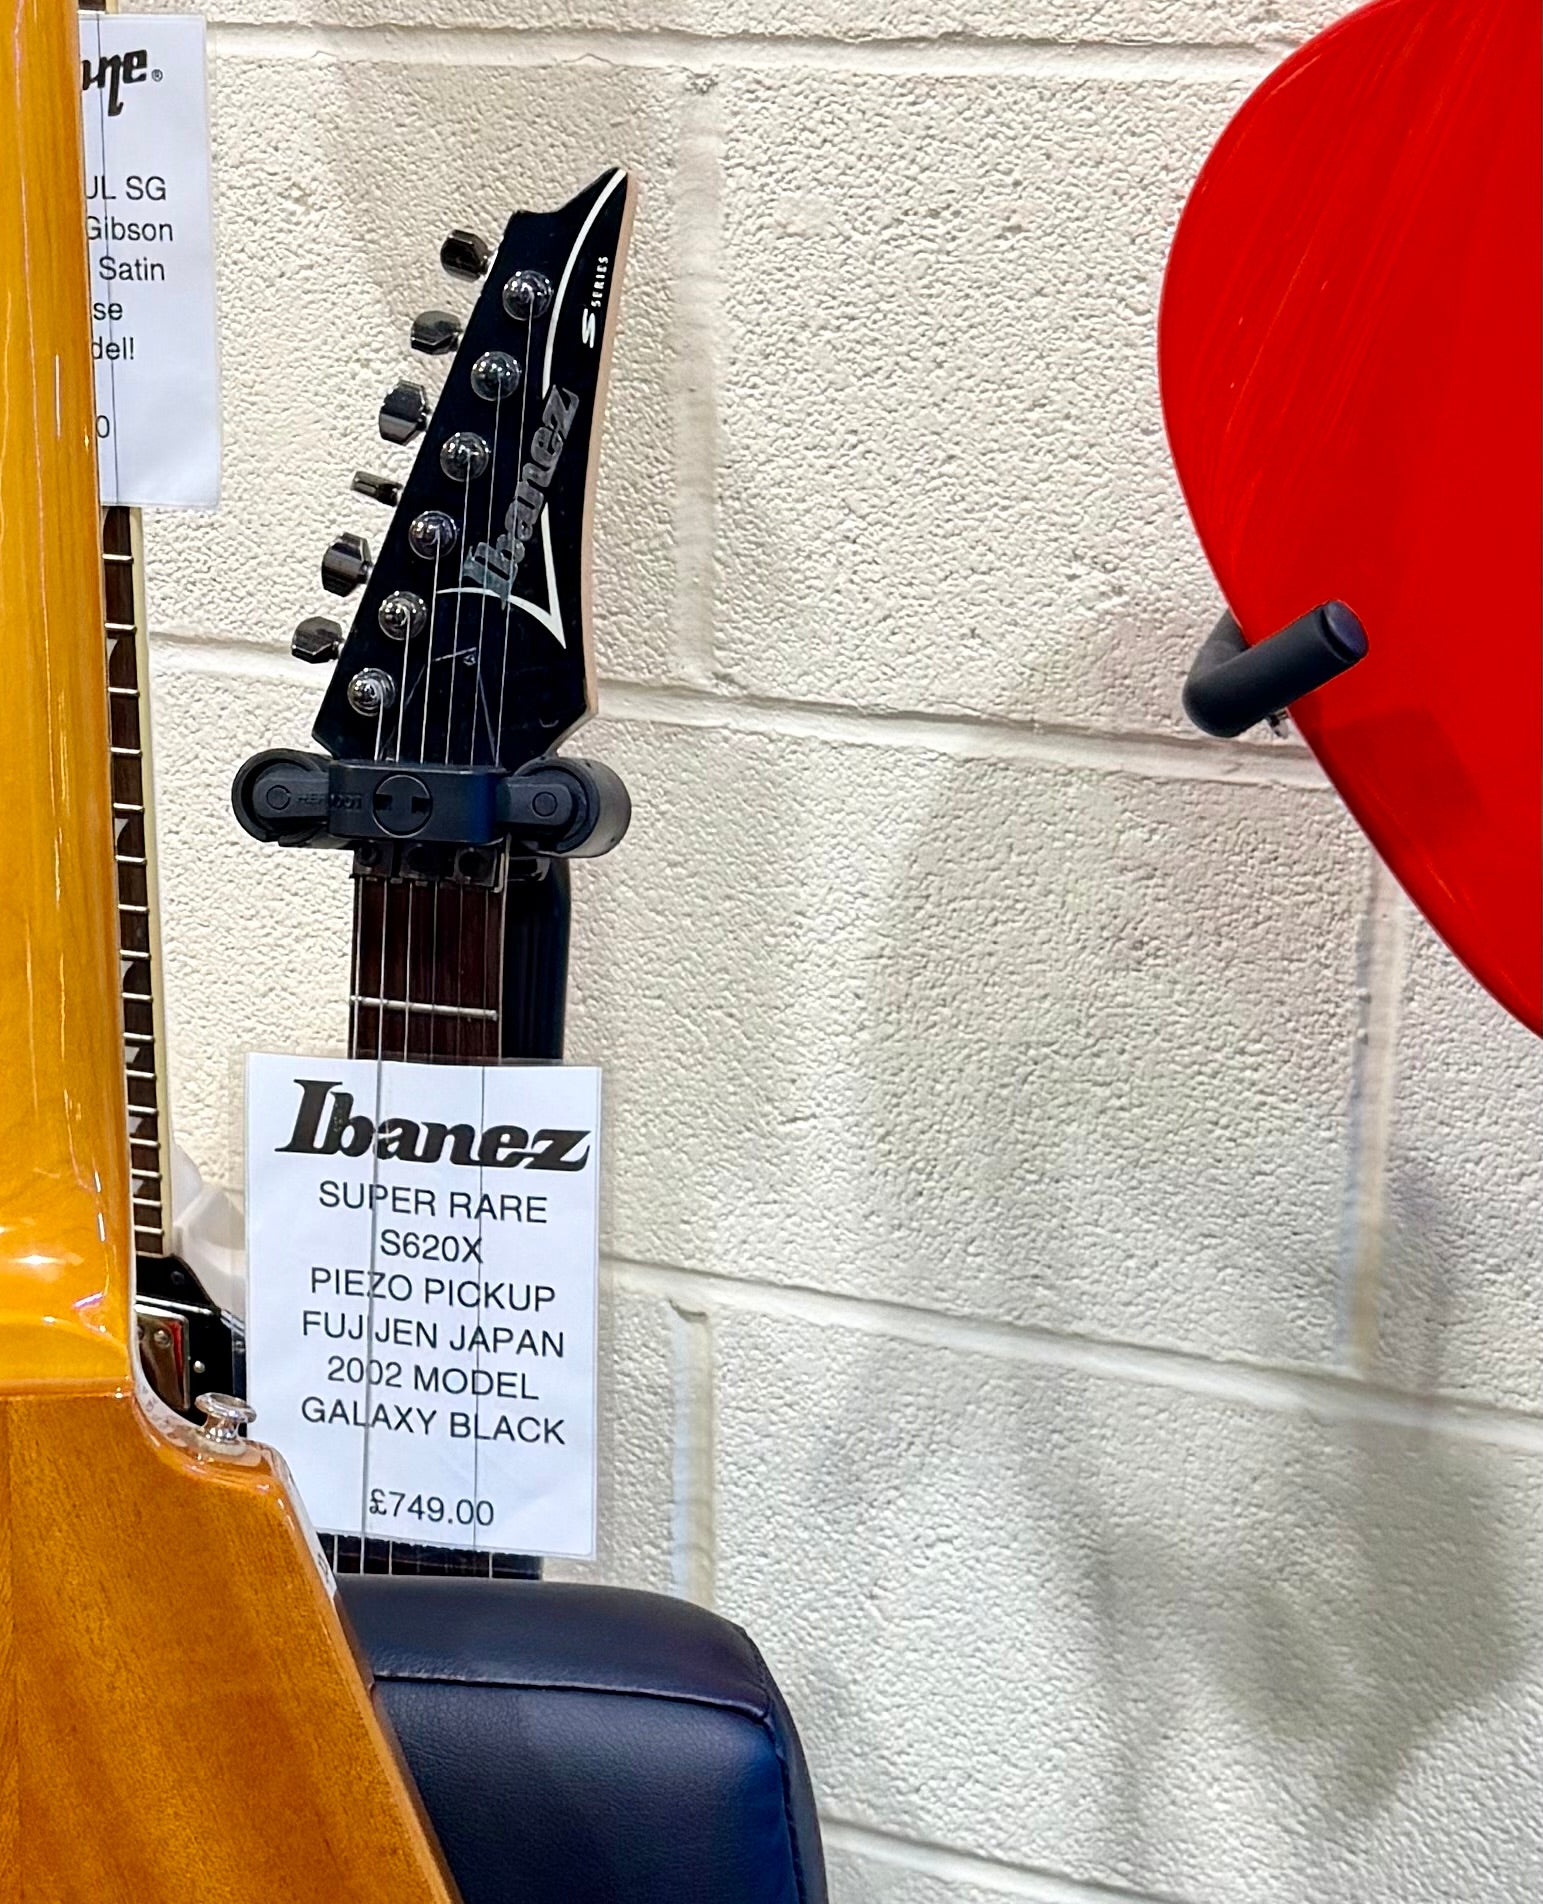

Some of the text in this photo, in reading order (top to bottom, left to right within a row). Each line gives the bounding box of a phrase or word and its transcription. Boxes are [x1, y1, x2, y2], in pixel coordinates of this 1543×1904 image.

[125, 175, 167, 201] SG
[87, 215, 174, 242] Gibson
[99, 255, 166, 282] Satin
[591, 256, 609, 308] SERIES
[462, 384, 580, 610] Ibanez
[274, 1078, 591, 1173] Ibanez
[318, 1180, 548, 1224] SUPER RARE
[380, 1229, 484, 1264] S620X
[311, 1267, 556, 1313] PIEZO PICKUP
[449, 1328, 564, 1358] JAPAN
[327, 1356, 539, 1401] 2002 MODEL
[301, 1397, 566, 1446] GALAXY BLACK
[370, 1489, 495, 1527] £749.00
